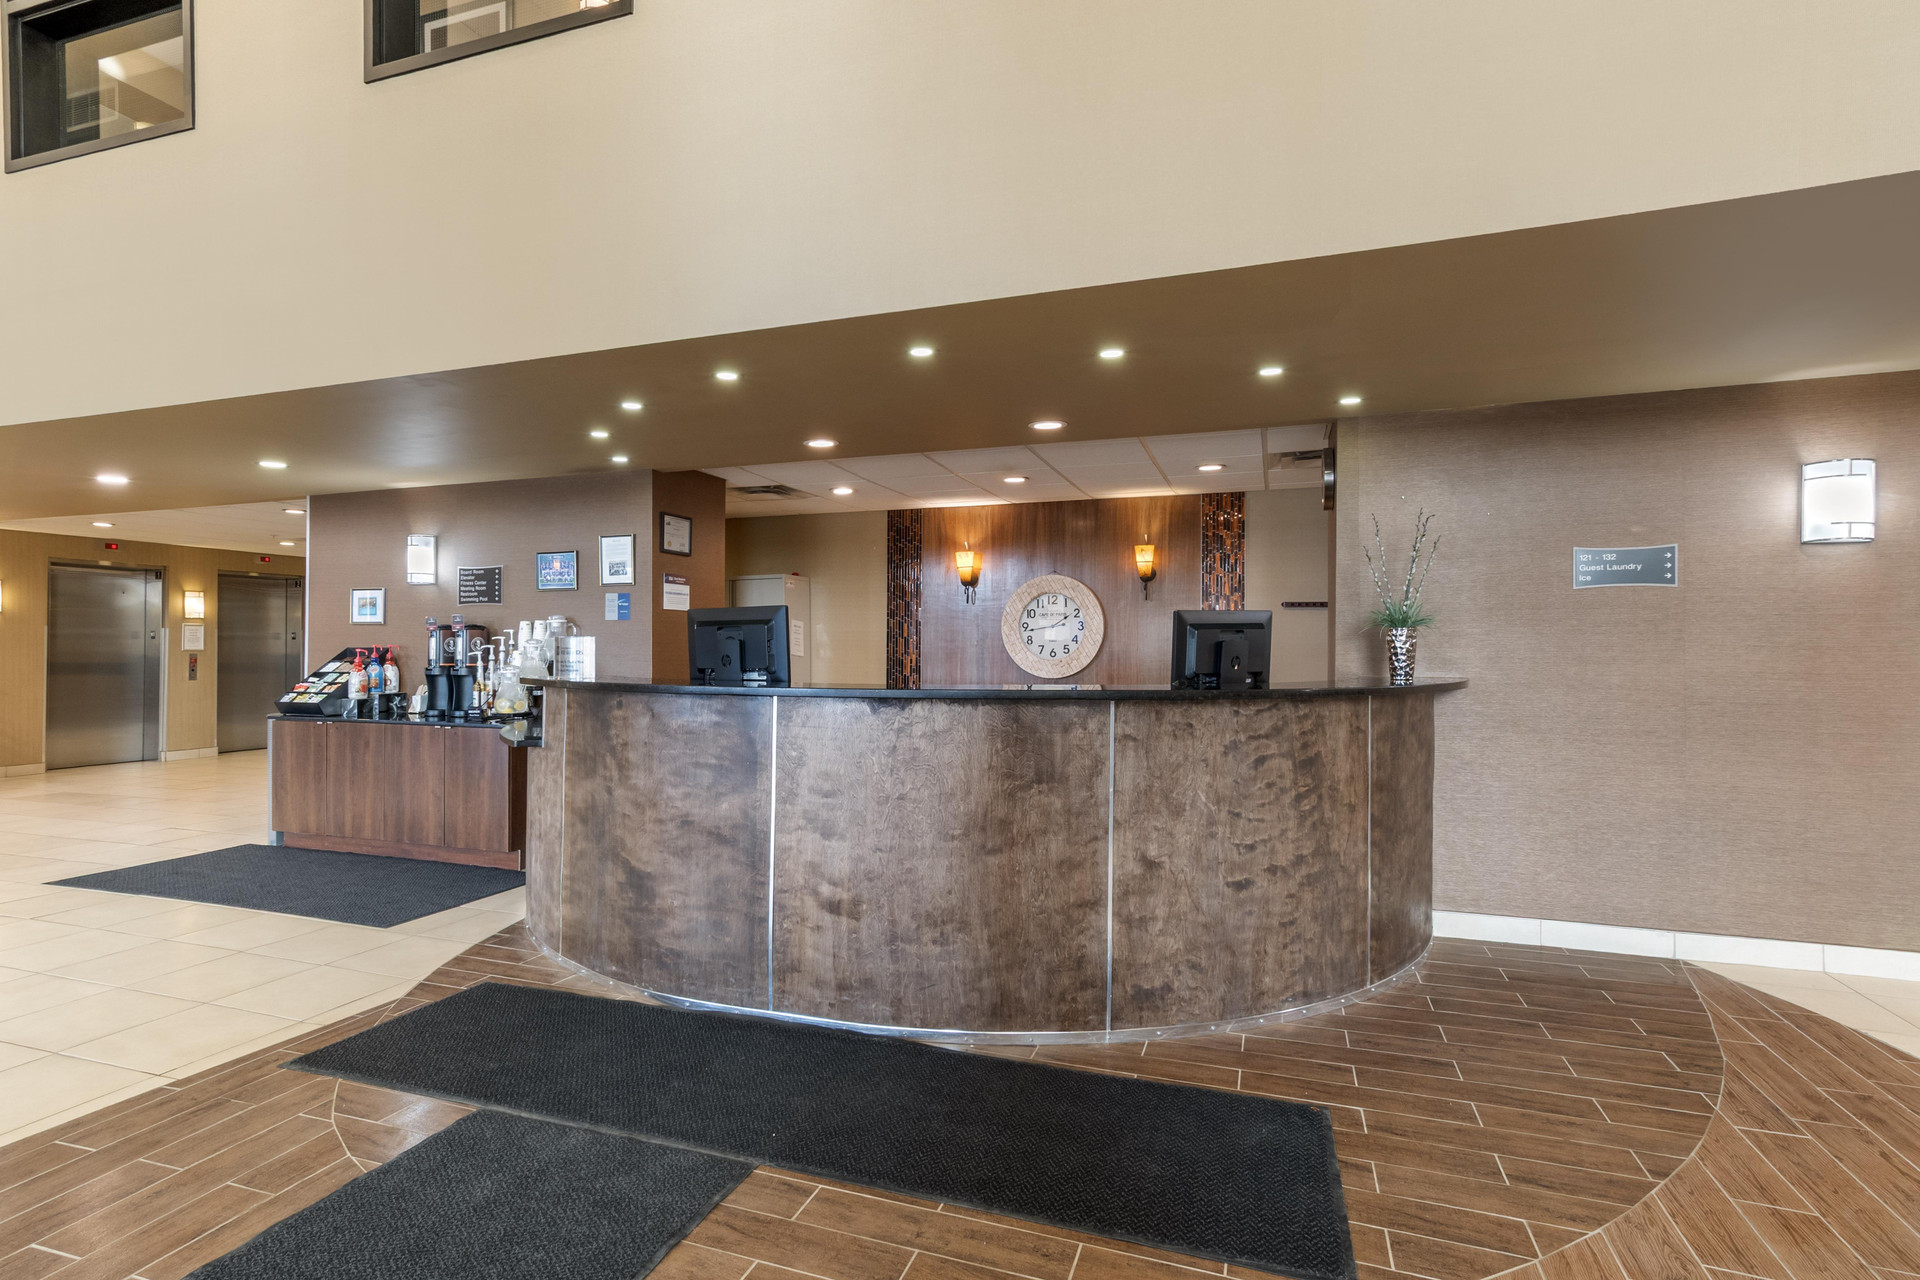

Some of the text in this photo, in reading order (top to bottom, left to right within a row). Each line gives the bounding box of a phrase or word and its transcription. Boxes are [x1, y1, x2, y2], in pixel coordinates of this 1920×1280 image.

[1602, 553, 1617, 561] 132
[1606, 563, 1642, 571] Laundry
[1036, 598, 1045, 609] 11
[1047, 594, 1058, 605] 12
[1026, 608, 1036, 619] 10
[1073, 608, 1081, 618] 2
[1021, 622, 1029, 632] 9
[1077, 621, 1085, 631] 3
[1026, 635, 1034, 645] 8
[1071, 634, 1079, 645] 4
[1038, 645, 1045, 655] 7
[1049, 648, 1057, 658] 6
[1063, 644, 1070, 654] 5
